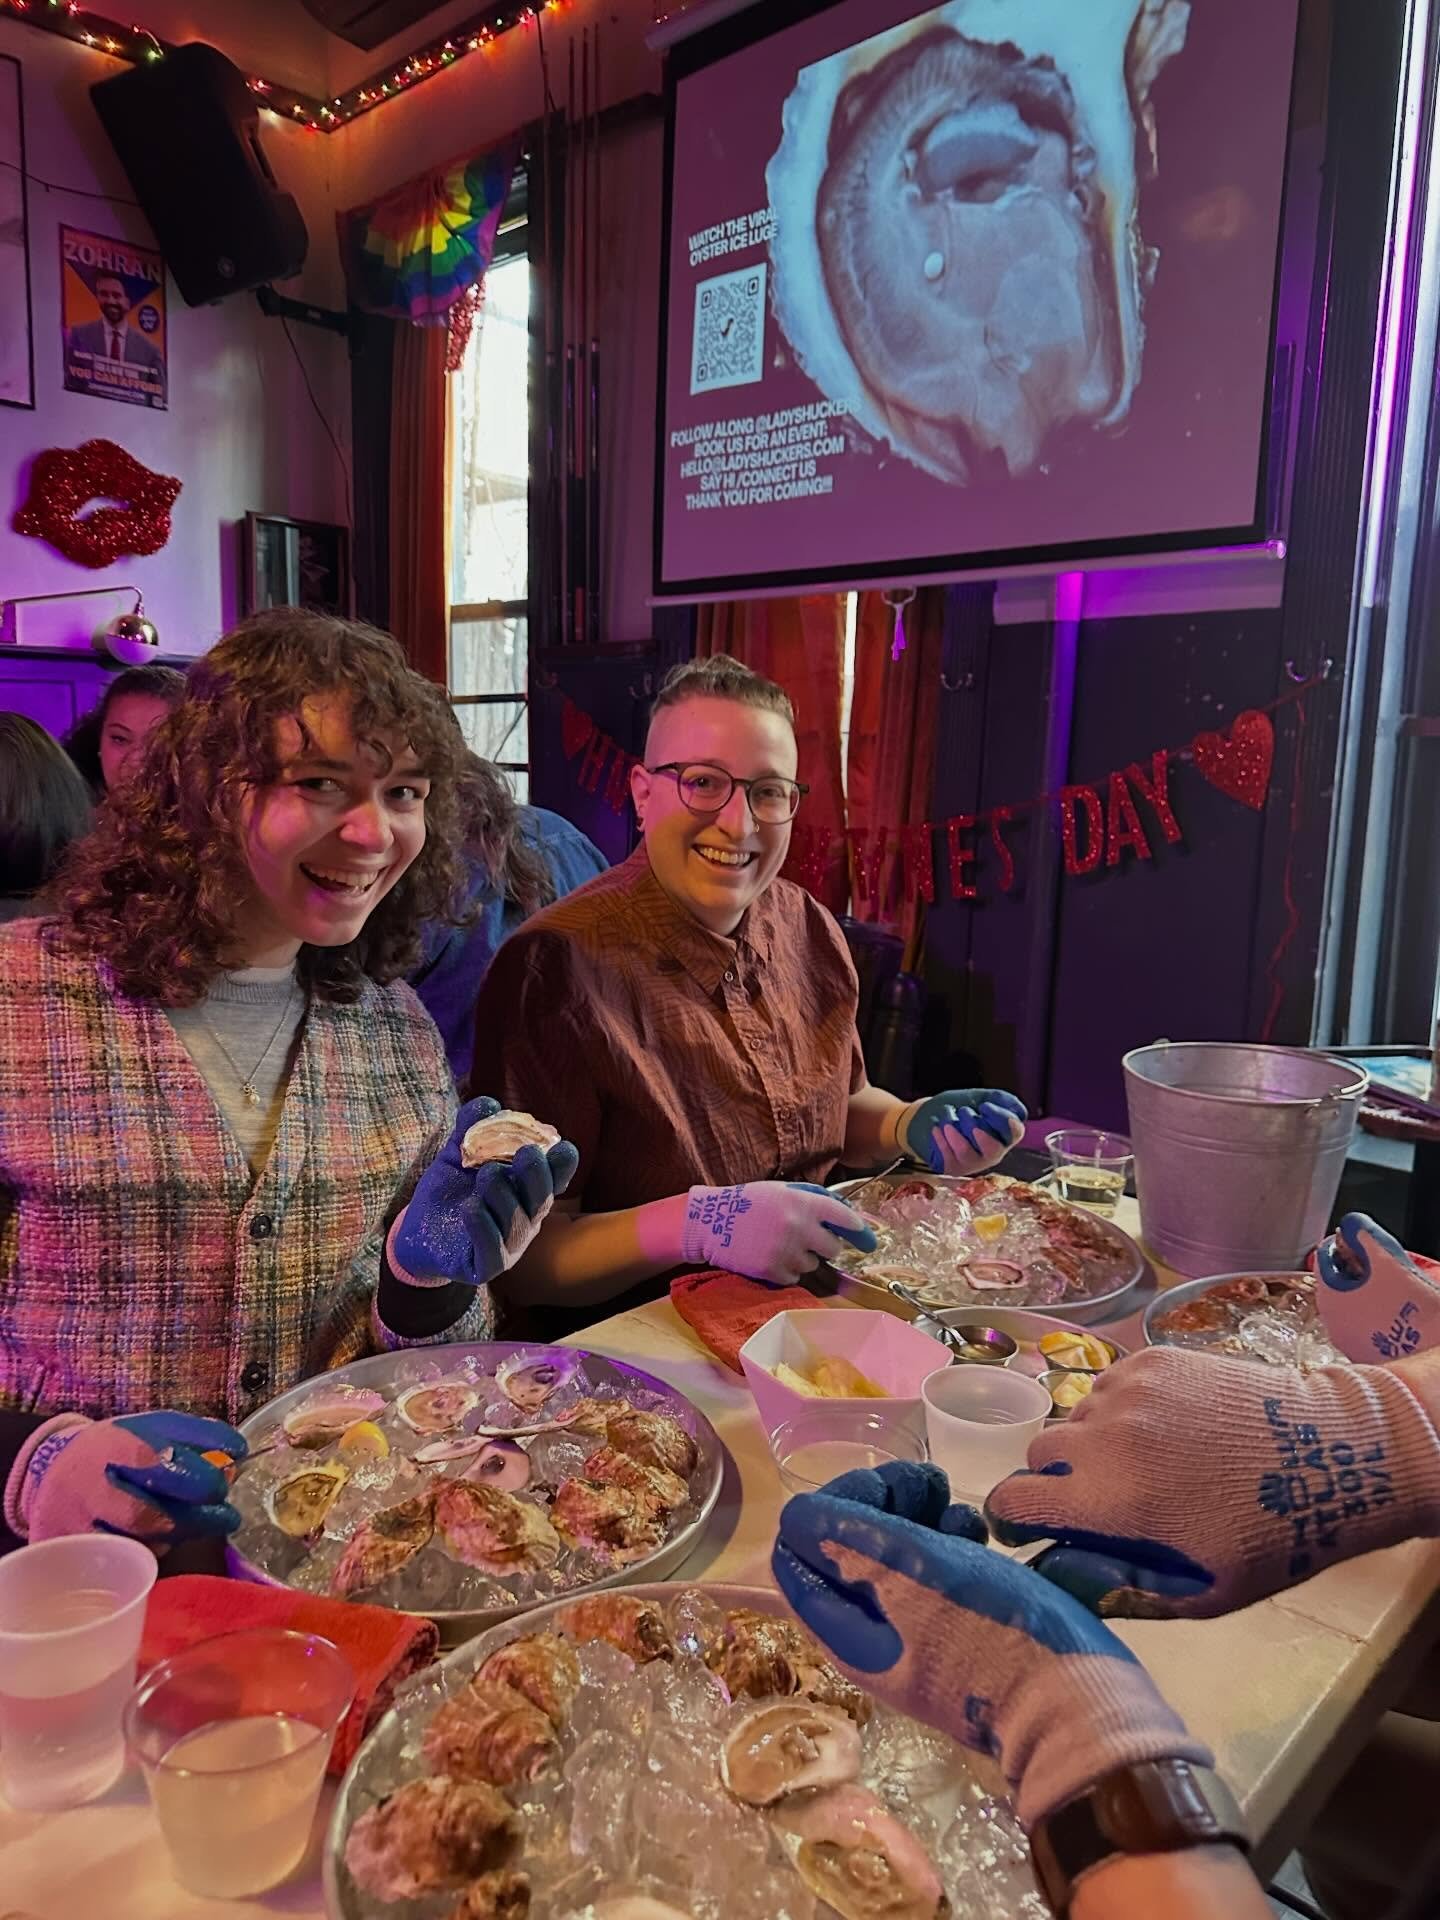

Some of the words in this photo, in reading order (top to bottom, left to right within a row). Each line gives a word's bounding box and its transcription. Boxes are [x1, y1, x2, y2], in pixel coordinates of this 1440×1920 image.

[689, 222, 724, 251] WATCH
[726, 215, 747, 236] THE
[690, 238, 728, 267] OYSTER
[730, 232, 748, 252] ICE
[749, 222, 778, 246] LUGE
[64, 240, 162, 283] ZOHRAN
[671, 421, 713, 447] FOLLOW
[714, 418, 754, 438] ALONG
[694, 440, 725, 458] BOOK
[727, 436, 744, 454] US
[745, 433, 769, 451] FOR
[770, 428, 786, 448] AN
[788, 420, 828, 443] EVENT:
[681, 436, 845, 478] HELLO@LADYSHUCKERS.COM
[701, 472, 722, 491] SAY
[724, 472, 736, 487] HI
[799, 460, 816, 477] US
[686, 492, 721, 510] THANK
[724, 489, 747, 506] YOU
[749, 486, 772, 504] FOR
[1060, 749, 1181, 876] DAY
[701, 1195, 718, 1224] 300
[712, 1189, 732, 1234] ATLAS
[1296, 1424, 1340, 1547] ATLAS
[1330, 1441, 1368, 1518] 300
